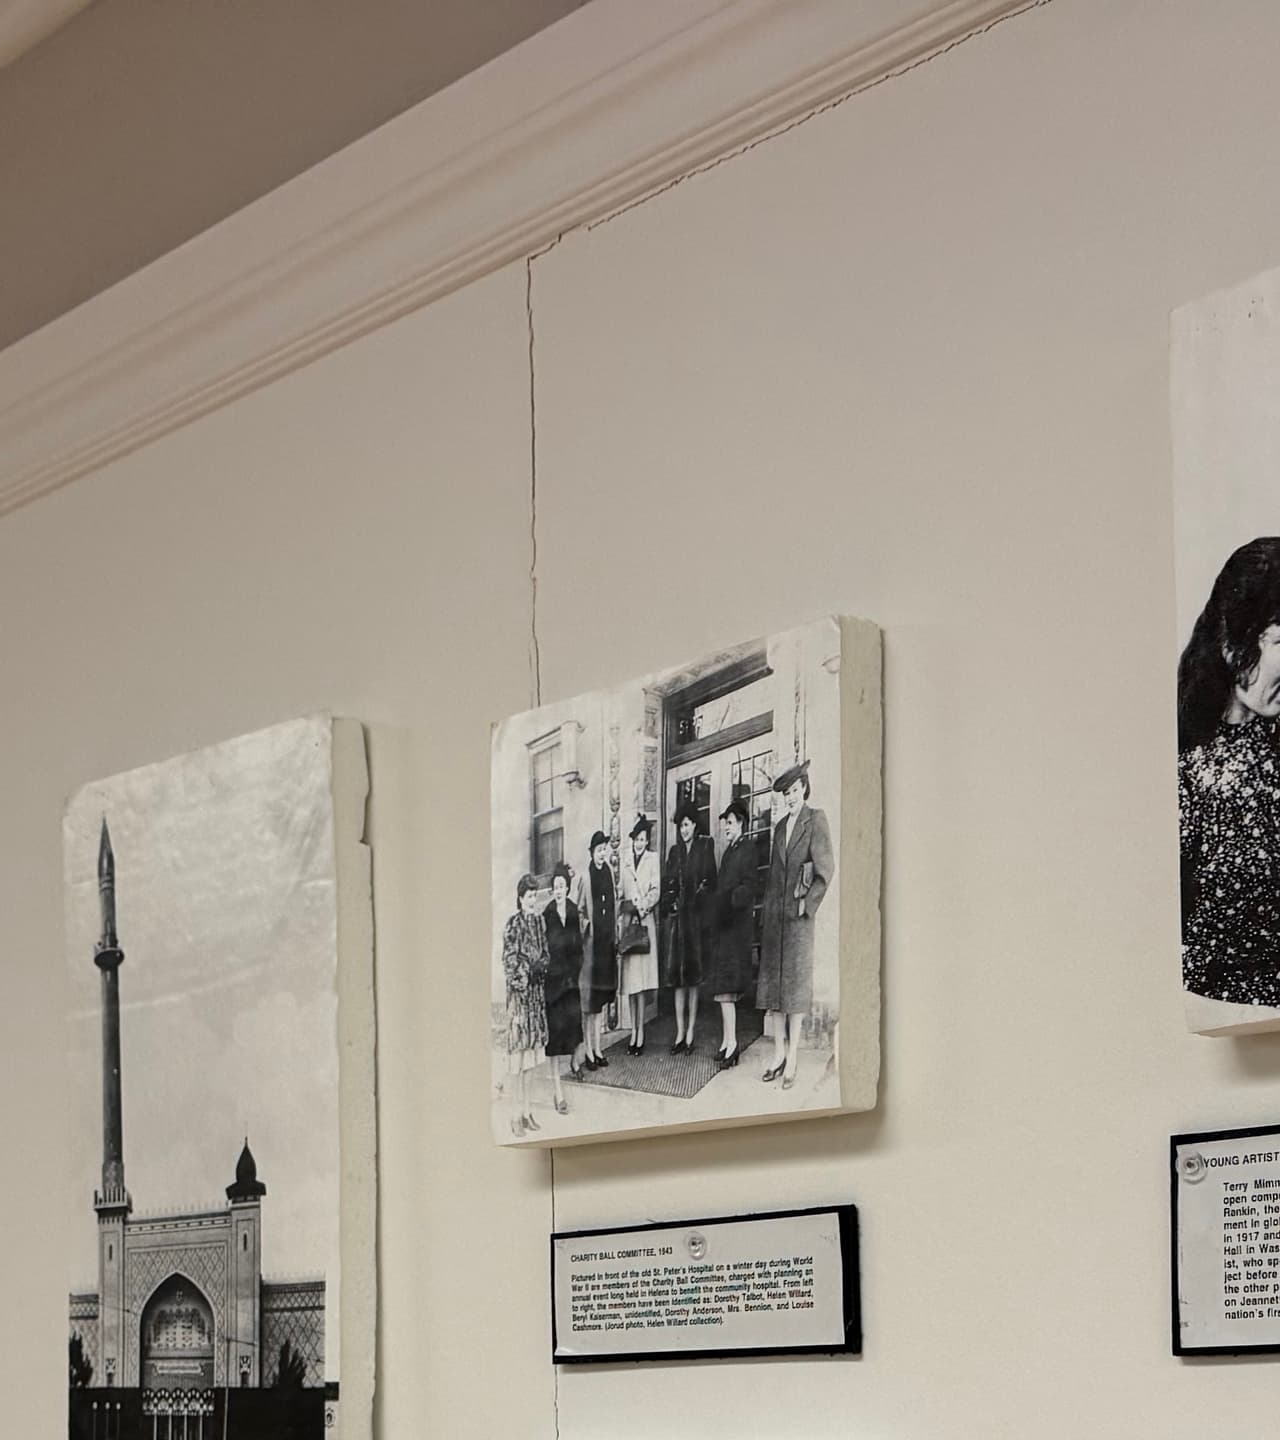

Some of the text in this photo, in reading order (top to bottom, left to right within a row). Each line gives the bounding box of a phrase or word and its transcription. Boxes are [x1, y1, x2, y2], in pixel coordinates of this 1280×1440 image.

[1203, 1155, 1239, 1169] YOUNG
[1241, 1151, 1280, 1165] ARTIST
[1224, 1181, 1248, 1195] Terry
